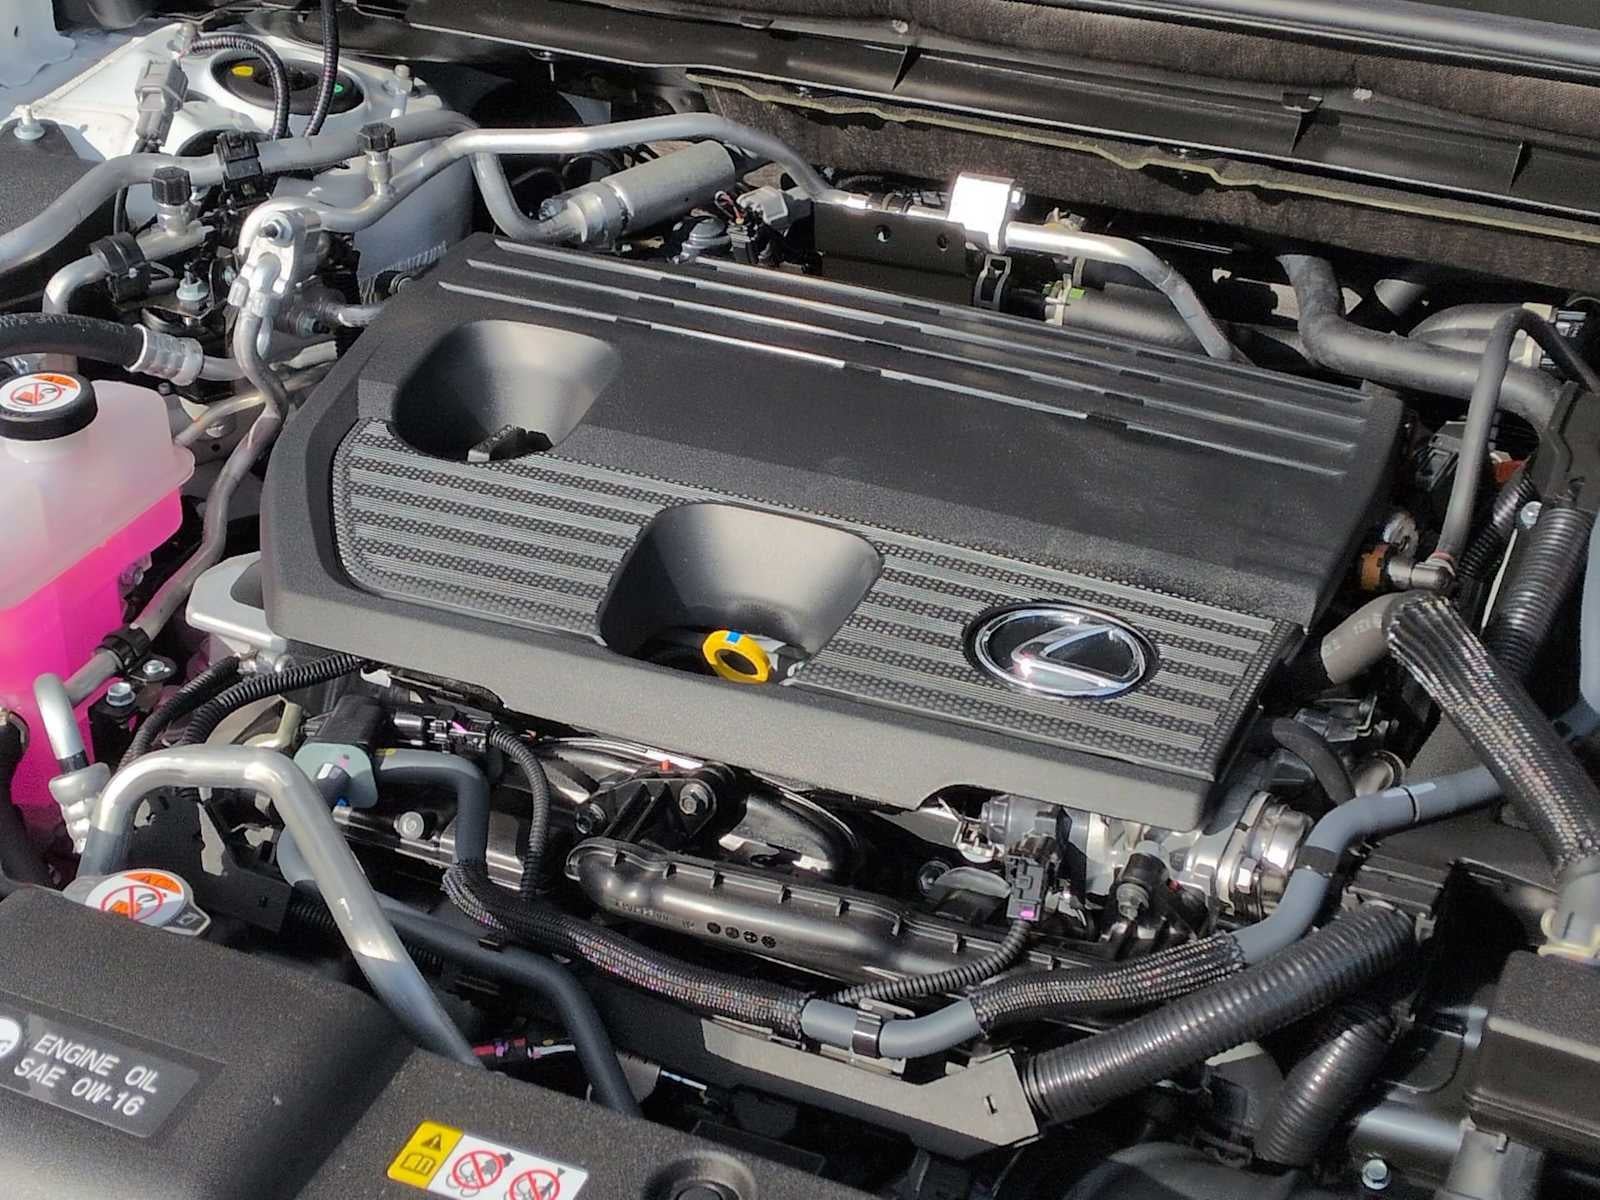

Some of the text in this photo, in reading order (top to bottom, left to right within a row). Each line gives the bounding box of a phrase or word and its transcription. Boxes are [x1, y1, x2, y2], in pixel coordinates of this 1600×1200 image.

[14, 1057, 67, 1088] SAE
[33, 1033, 159, 1093] ENGINE OIL
